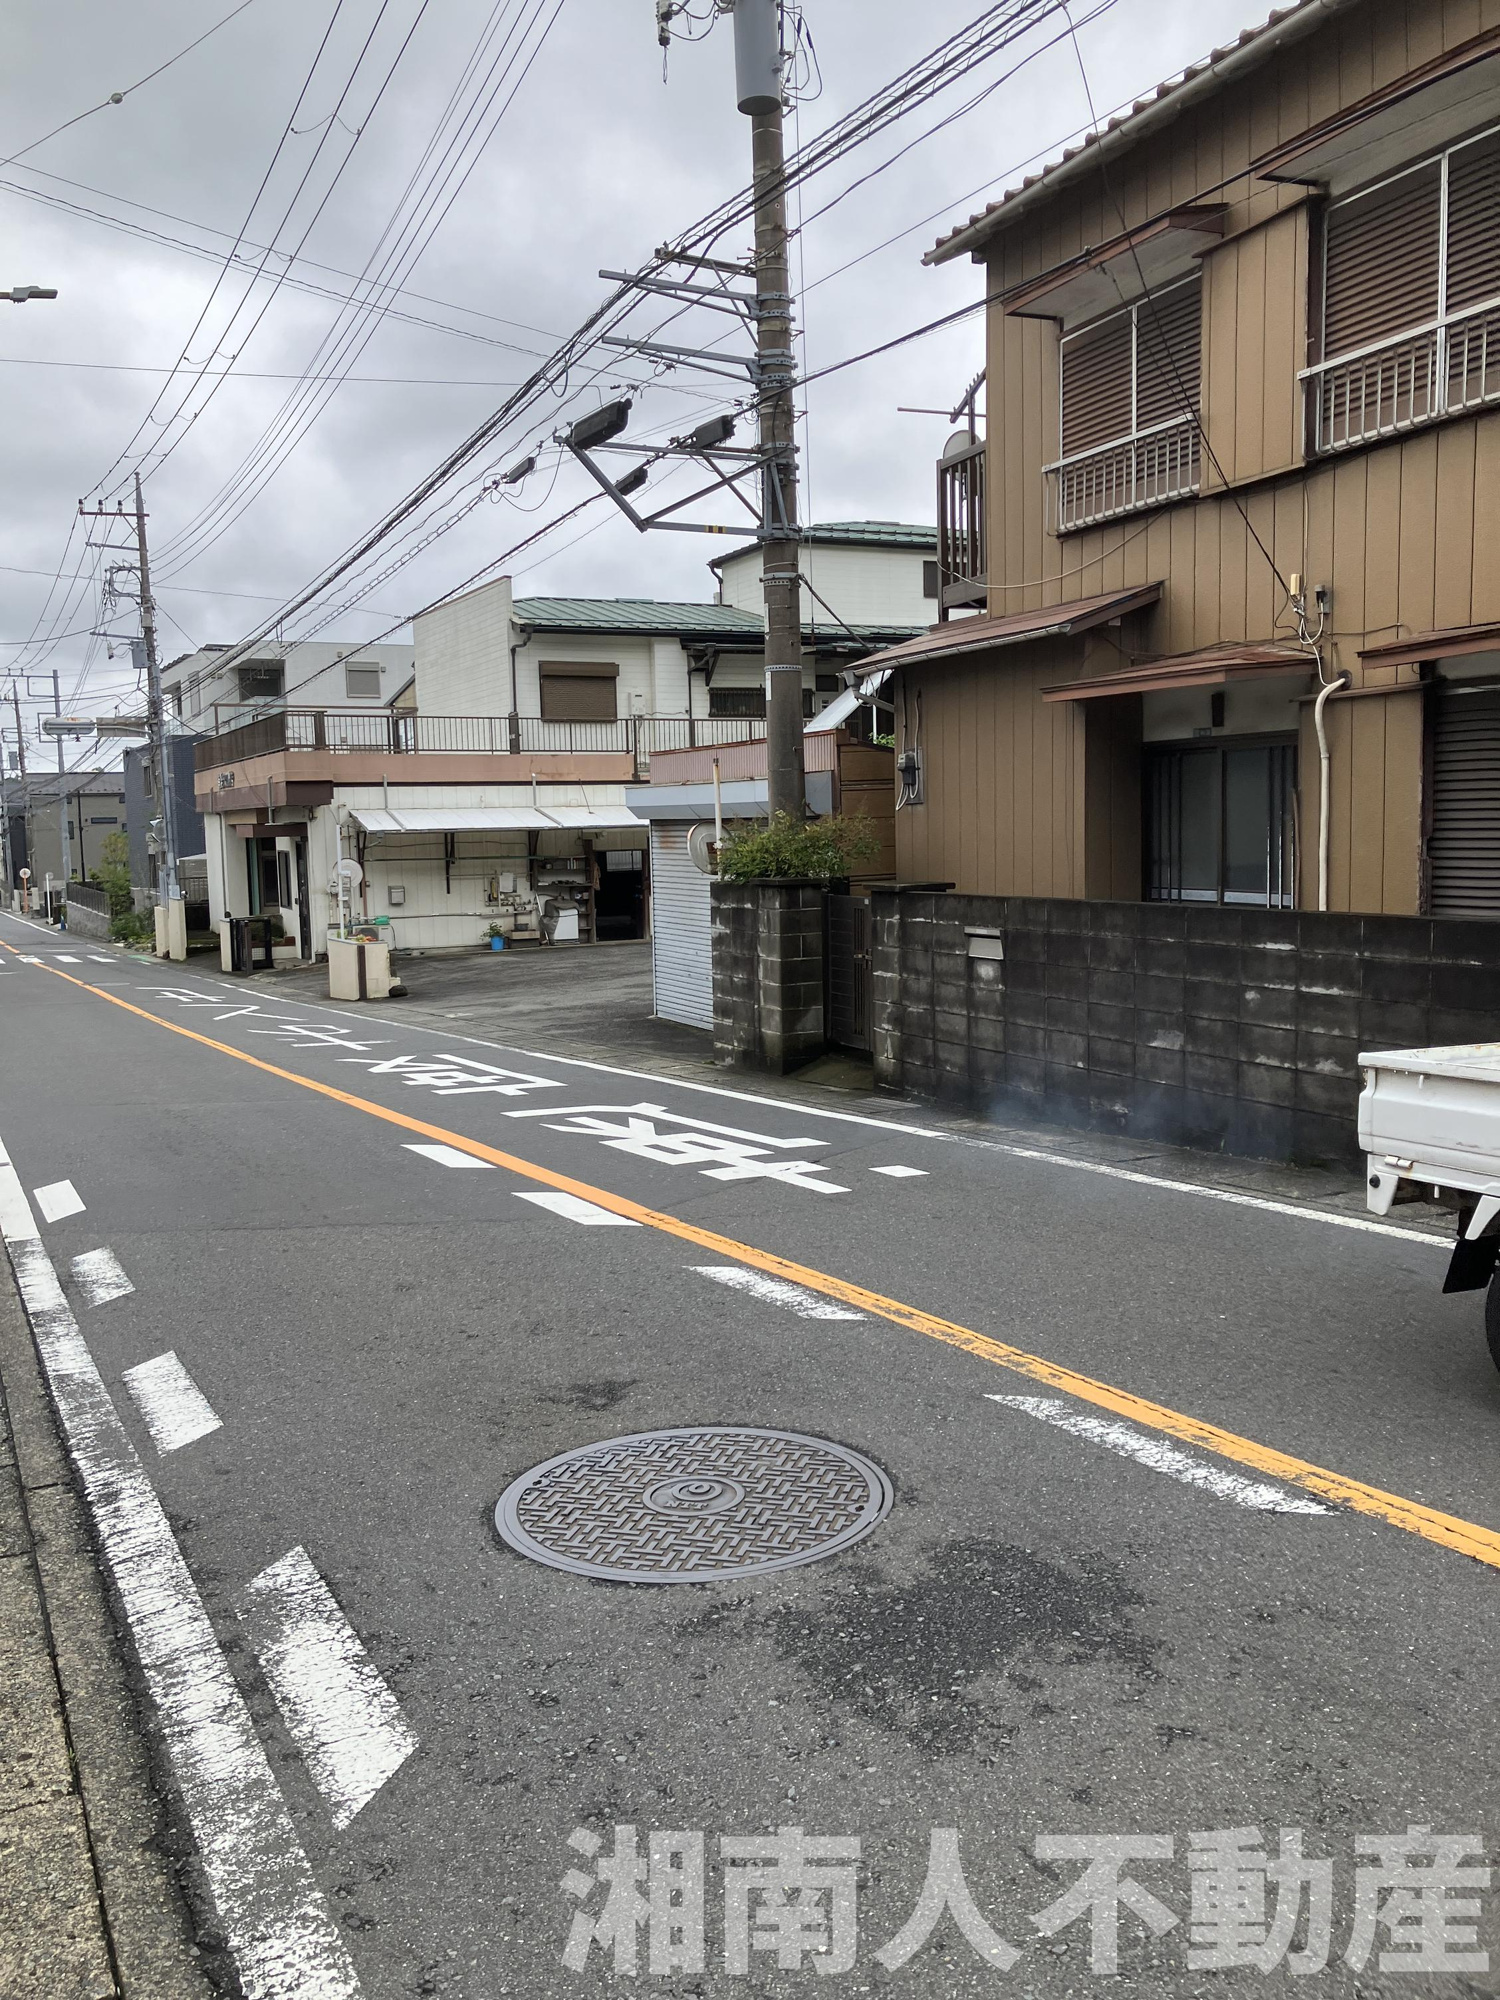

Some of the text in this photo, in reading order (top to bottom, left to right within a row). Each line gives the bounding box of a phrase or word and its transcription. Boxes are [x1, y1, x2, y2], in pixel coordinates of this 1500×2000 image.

[135, 986, 852, 1194] 速度おとせ
[664, 1500, 708, 1510] NTT
